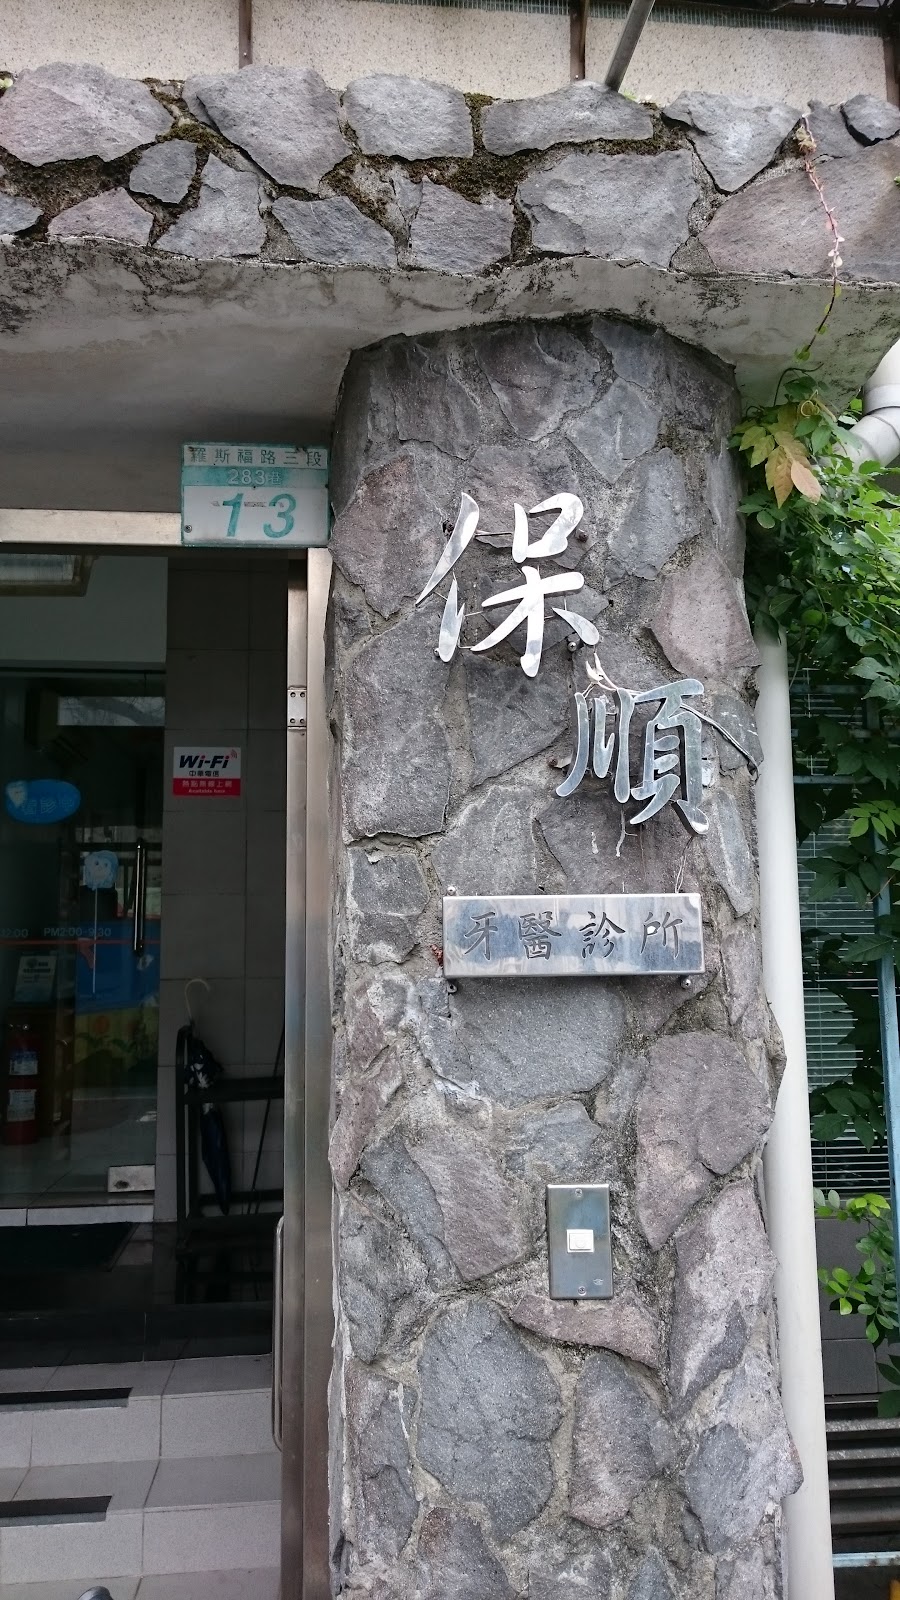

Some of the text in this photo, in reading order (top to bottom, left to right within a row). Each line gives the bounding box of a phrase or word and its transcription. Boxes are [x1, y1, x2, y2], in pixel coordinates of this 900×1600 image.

[190, 447, 322, 467] 羅斯福路三段
[227, 468, 283, 486] 283巷
[178, 754, 230, 769] Wi-Fi
[463, 910, 684, 962] 牙醫診所
